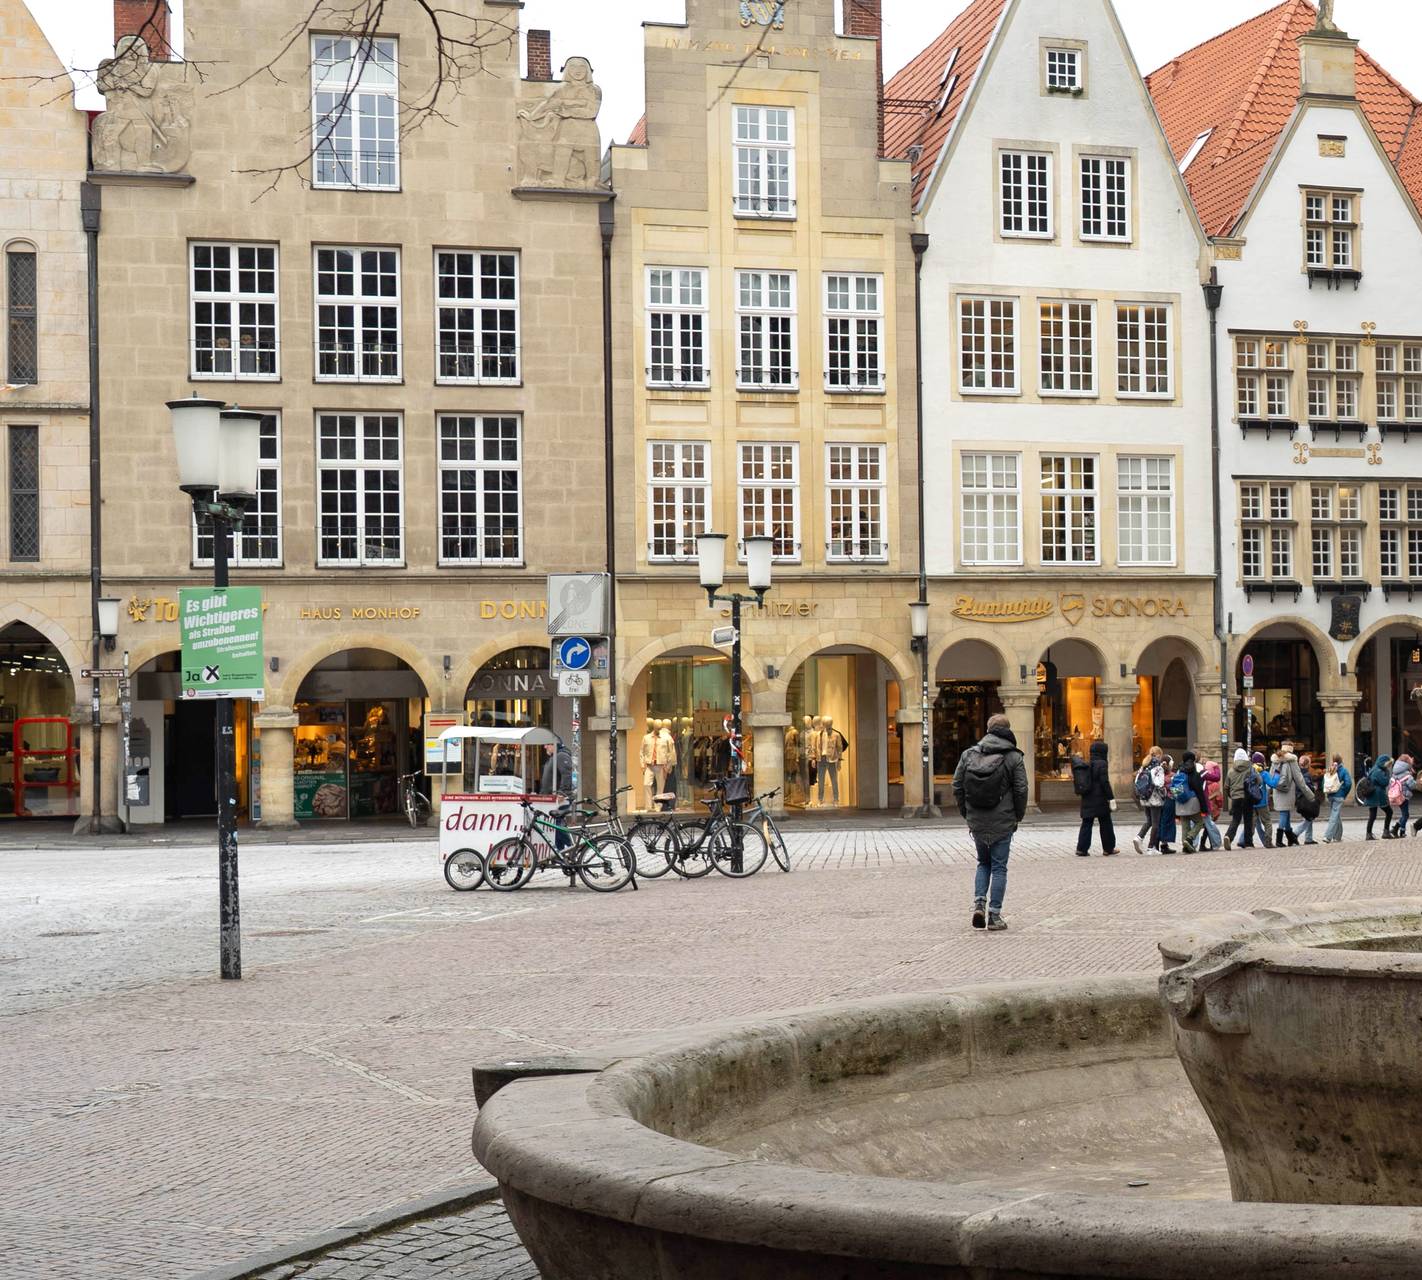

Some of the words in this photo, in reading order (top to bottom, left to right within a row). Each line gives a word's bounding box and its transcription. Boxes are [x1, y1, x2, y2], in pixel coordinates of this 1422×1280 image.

[186, 599, 200, 613] Es
[202, 595, 228, 611] gibt
[1091, 597, 1189, 618] SIGNORA
[183, 608, 259, 629] Wichtigeres
[301, 607, 341, 620] HAUS
[352, 607, 420, 620] MONHOF
[189, 629, 202, 640] als
[202, 625, 236, 638] Straßen
[185, 671, 200, 682] Ja
[468, 674, 546, 691] ONNA
